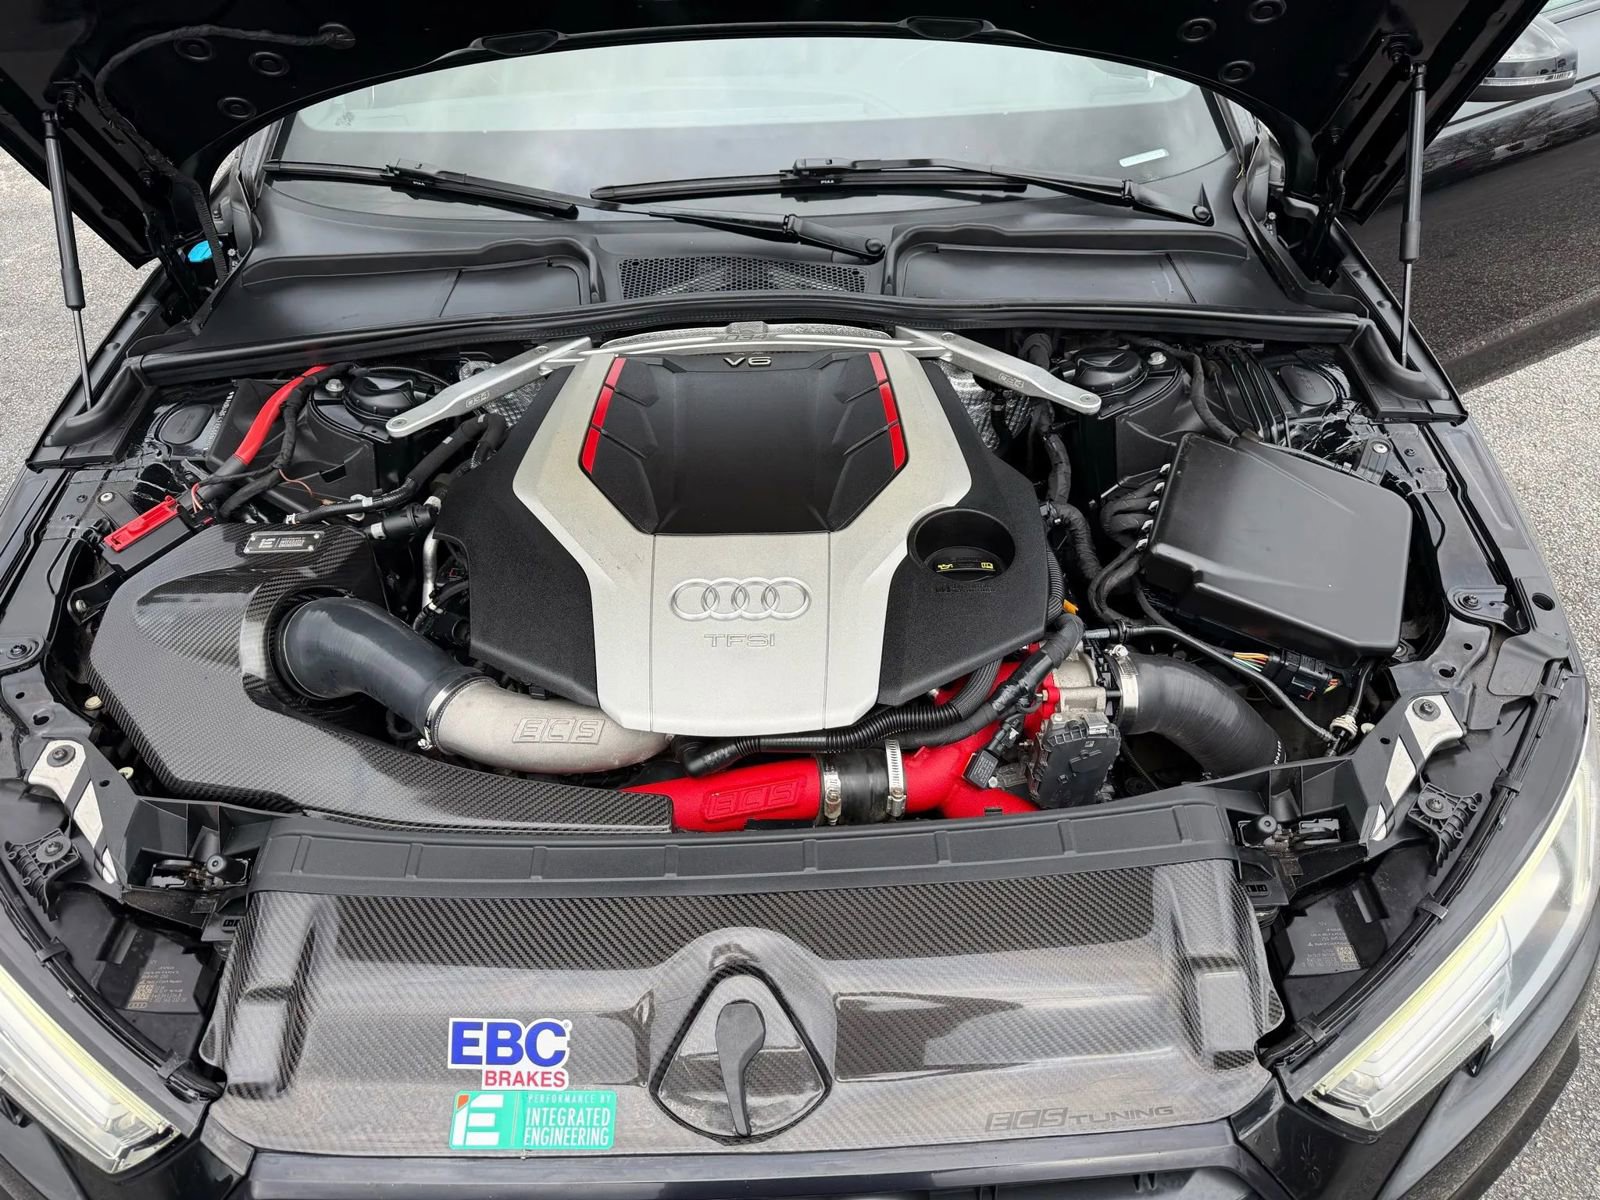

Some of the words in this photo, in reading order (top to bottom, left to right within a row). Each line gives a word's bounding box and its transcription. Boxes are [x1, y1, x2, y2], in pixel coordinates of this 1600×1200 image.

[723, 356, 771, 367] V6
[703, 633, 775, 648] TFSI
[512, 718, 605, 745] ECS
[705, 780, 799, 820] ECS
[484, 1070, 566, 1088] BRAKES
[528, 1093, 596, 1104] PERFORMANCE
[600, 1093, 612, 1104] BY
[525, 1107, 611, 1127] INTEGRATED
[985, 1106, 1069, 1132] ECS
[1068, 1105, 1175, 1125] TUNING
[523, 1126, 609, 1147] ENGINEERING
